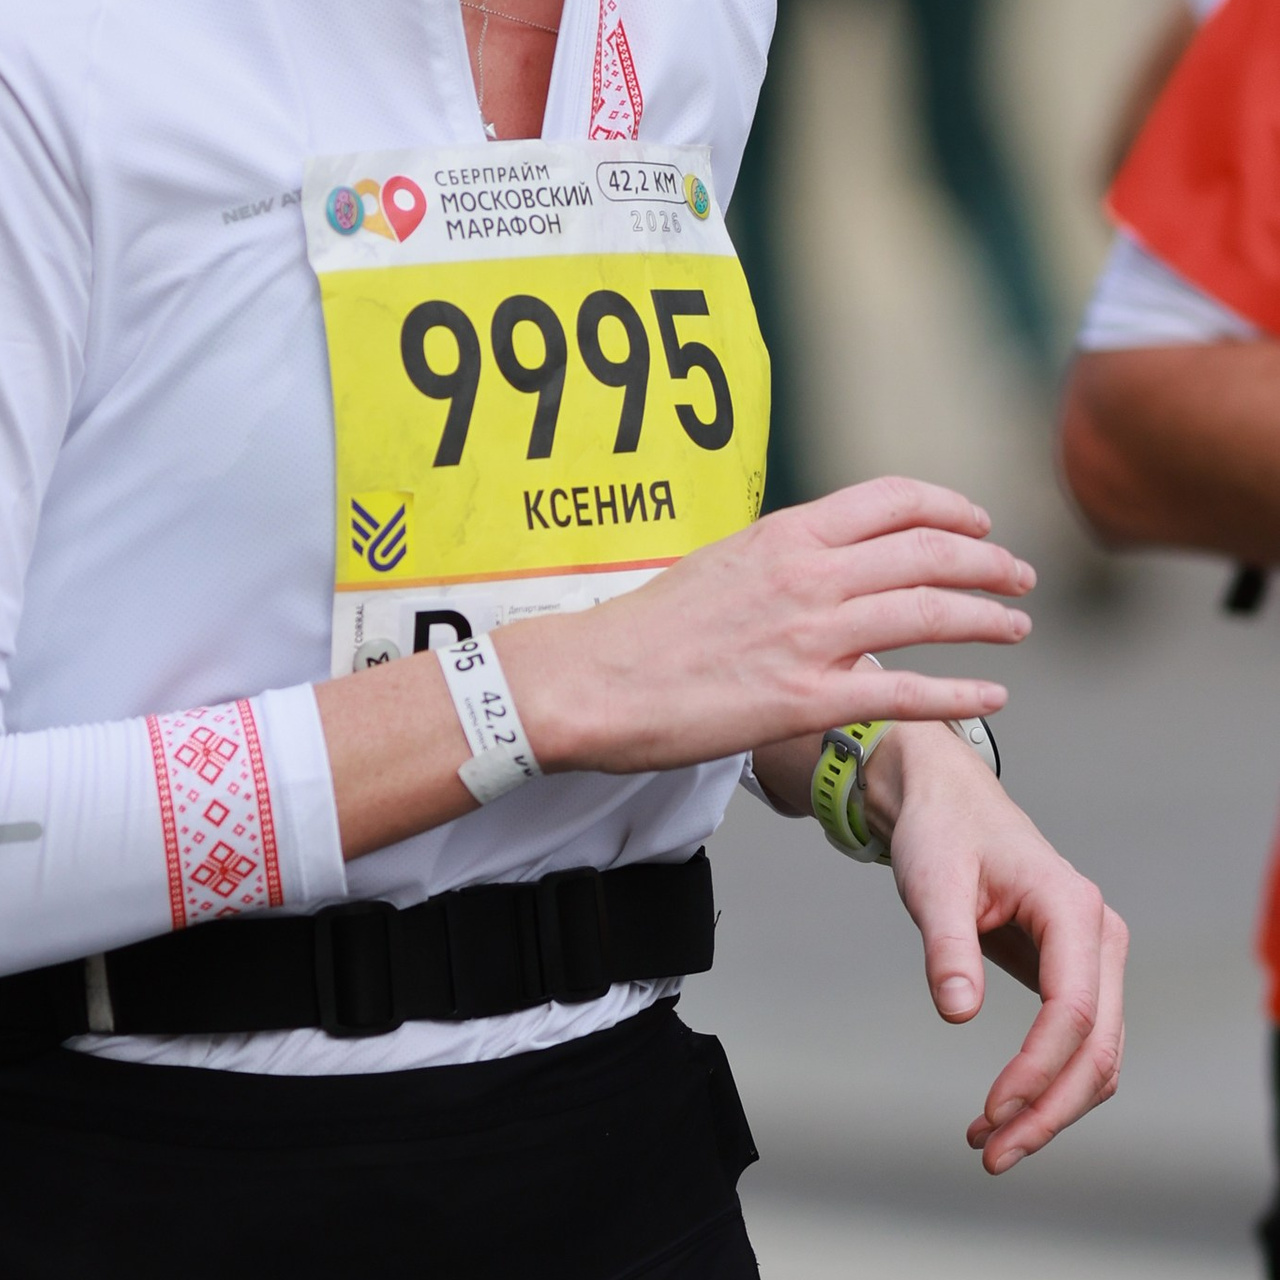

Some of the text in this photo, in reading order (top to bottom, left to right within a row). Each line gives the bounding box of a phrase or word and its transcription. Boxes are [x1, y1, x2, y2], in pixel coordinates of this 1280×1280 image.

[434, 163, 550, 187] СБЕРПРАЙМ
[608, 169, 649, 196] 42,2
[222, 196, 274, 225] NEW
[440, 180, 595, 214] МОСКОВСКИЙ
[445, 213, 563, 241] МАРАФОН
[630, 209, 682, 233] 2026
[399, 288, 735, 468] 9995
[523, 479, 677, 531] КСЕНИЯ
[481, 691, 517, 746] 42,2
